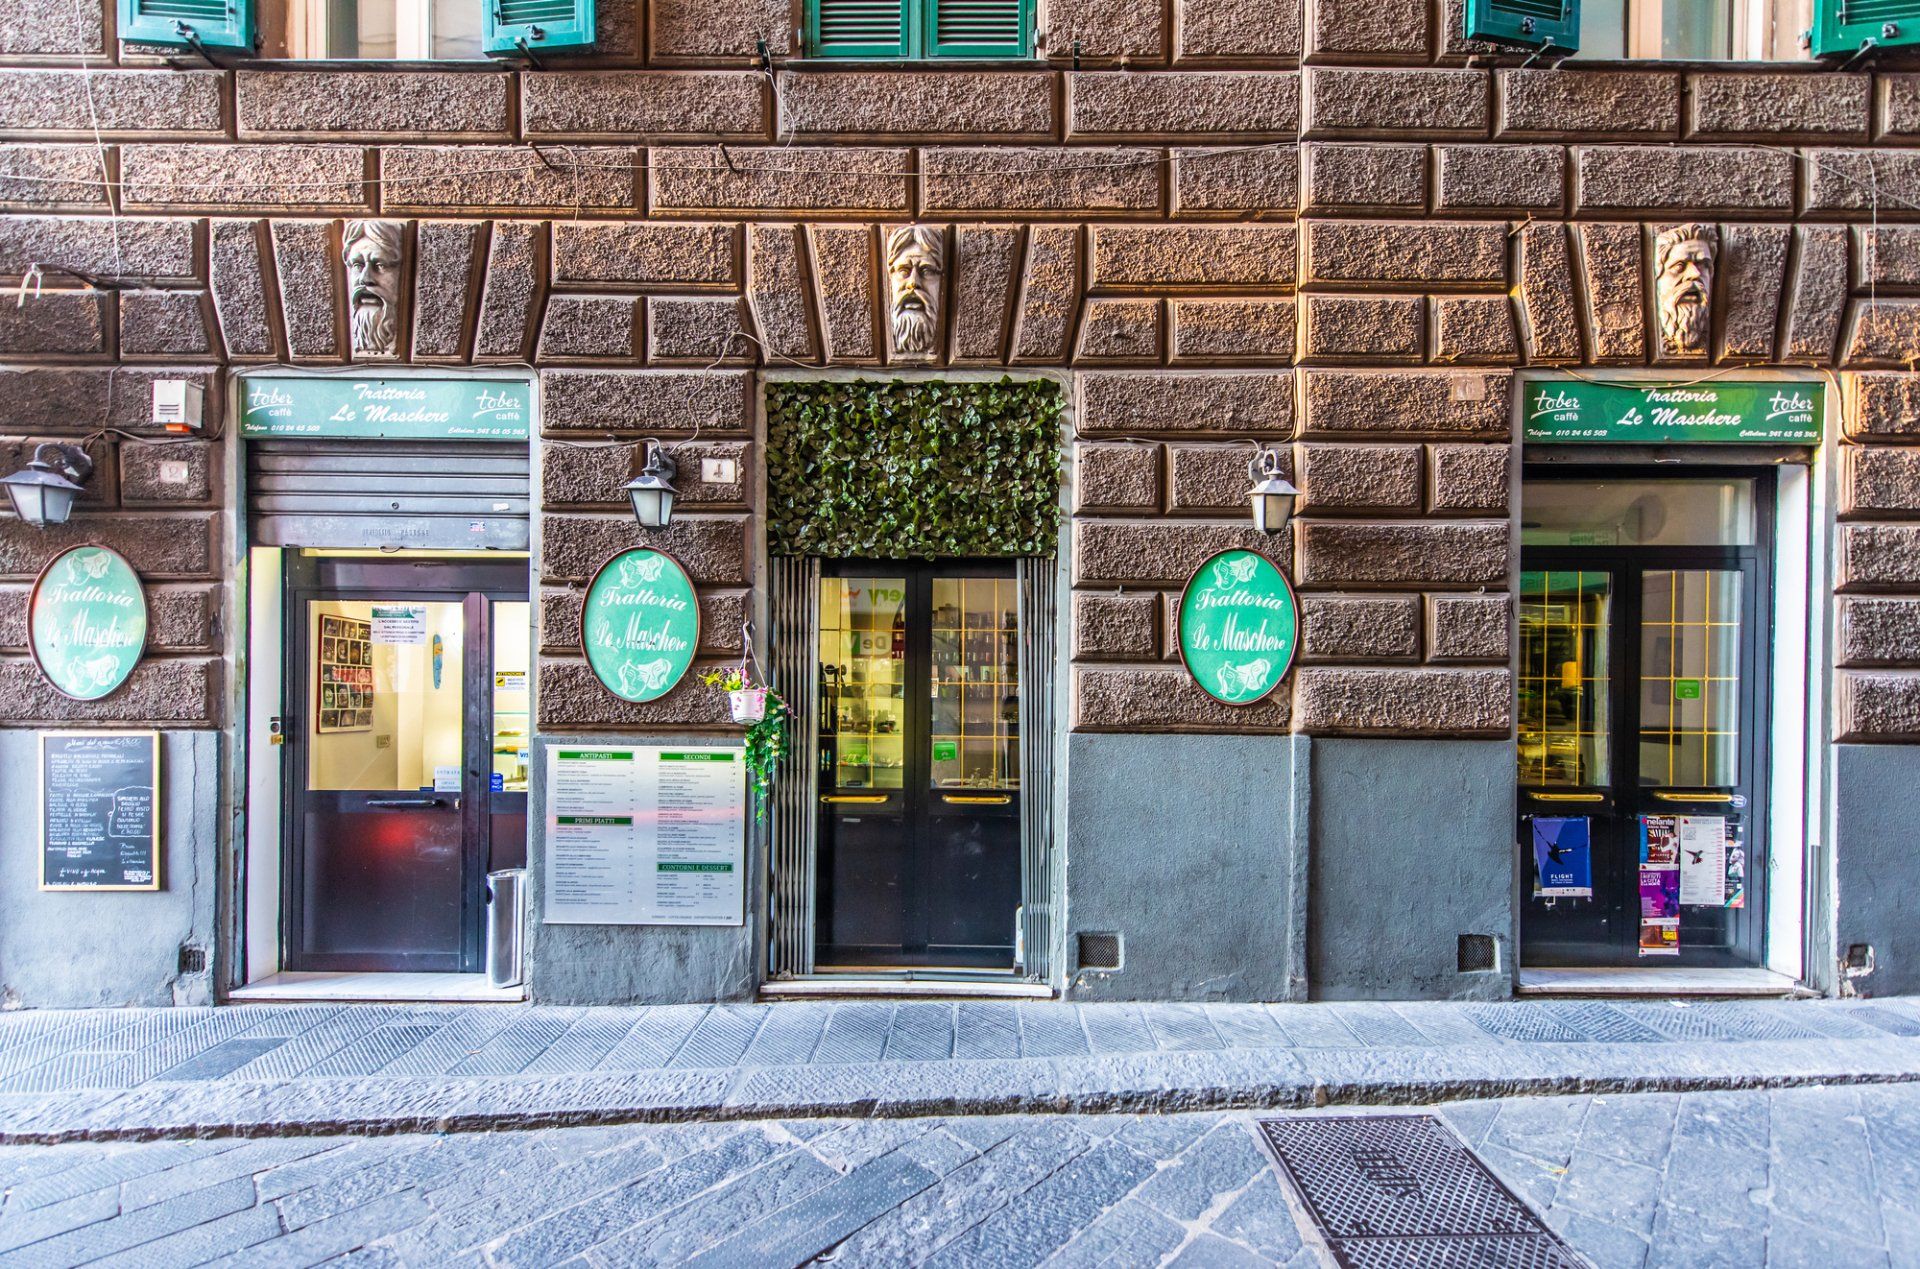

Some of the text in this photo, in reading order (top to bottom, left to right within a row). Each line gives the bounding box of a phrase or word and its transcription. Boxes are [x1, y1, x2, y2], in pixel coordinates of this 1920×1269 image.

[250, 386, 295, 407] tober
[353, 383, 427, 401] Trattoria
[475, 389, 523, 410] tober
[1533, 390, 1581, 410] tober
[1640, 388, 1718, 404] Trattoria
[1769, 391, 1815, 411] tober
[268, 407, 292, 417] caffè
[329, 404, 450, 424] Le Maschere
[495, 411, 520, 421] caffè
[1553, 411, 1579, 421] caffè
[1616, 407, 1742, 427] Le Maschere
[1788, 413, 1813, 423] caffè
[49, 584, 135, 608] Trattoria
[600, 586, 688, 612] Trattoria
[1195, 588, 1283, 611] Trattoria
[45, 609, 135, 647] Le Maschere
[595, 611, 688, 652] Le Maschere
[1192, 612, 1286, 652] Le Maschere
[579, 752, 613, 760] ANTIPASTI
[683, 753, 711, 761] SECONDI
[662, 864, 695, 872] CONTORNI
[701, 865, 729, 873] DESSERT
